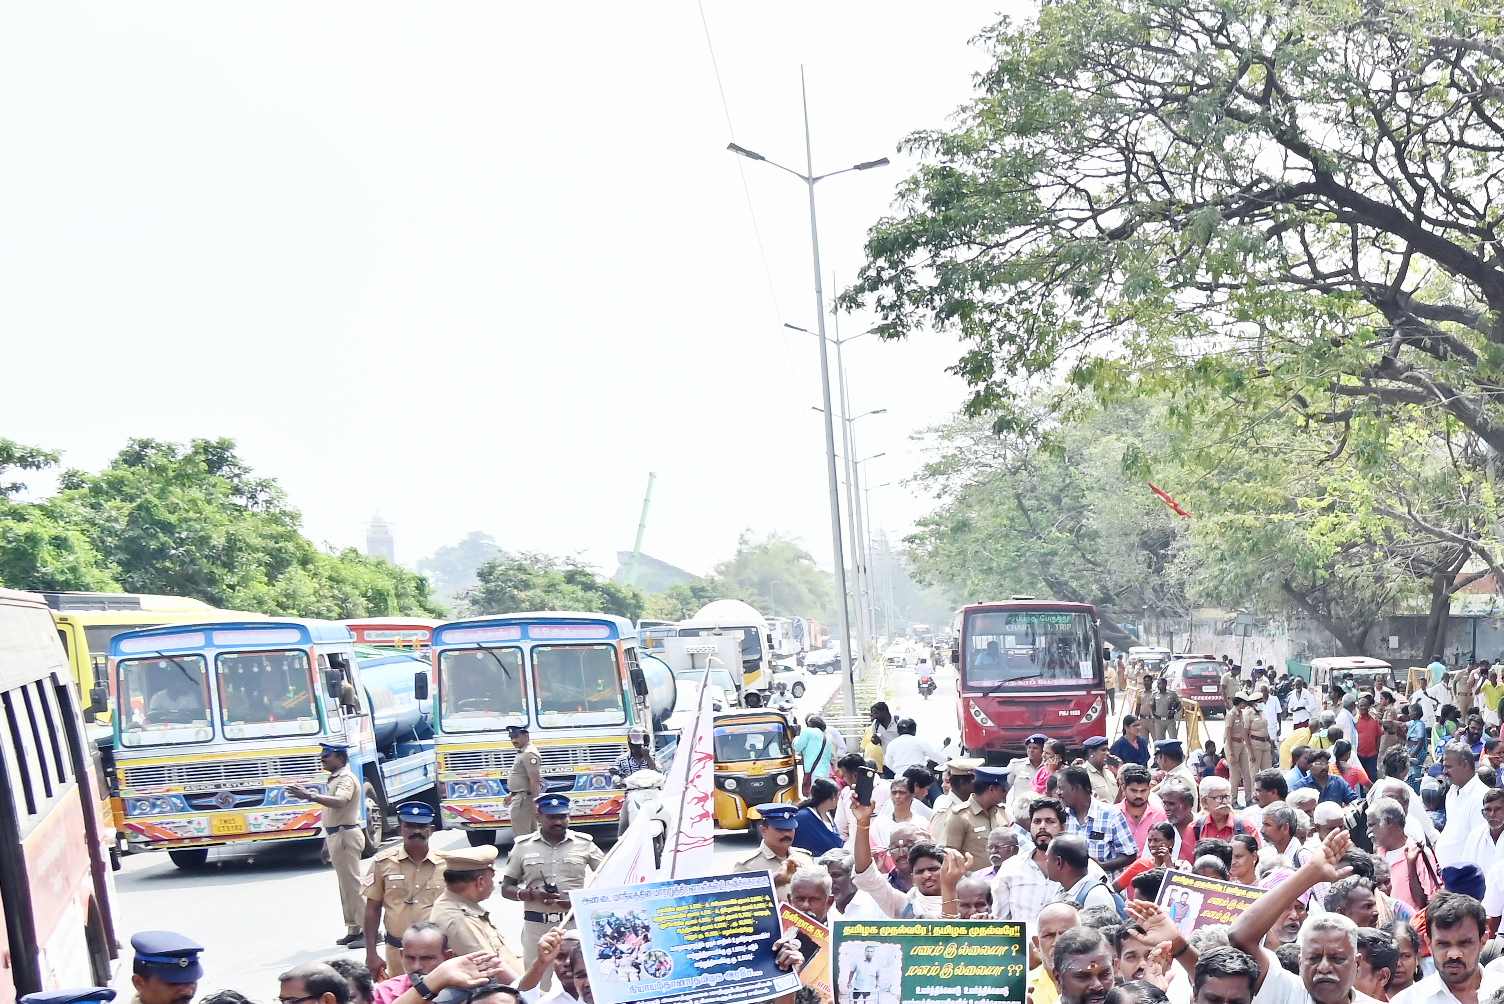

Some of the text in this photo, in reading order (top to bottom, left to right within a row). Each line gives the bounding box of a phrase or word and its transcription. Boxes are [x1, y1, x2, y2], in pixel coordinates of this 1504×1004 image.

[842, 923, 878, 936] தமிழக
[879, 923, 927, 936] முதல்வரே
[933, 924, 966, 936] தமிழக
[969, 924, 1020, 936] முதல்வரே!!
[1011, 943, 1019, 956] ?
[1007, 964, 1023, 976] ??
